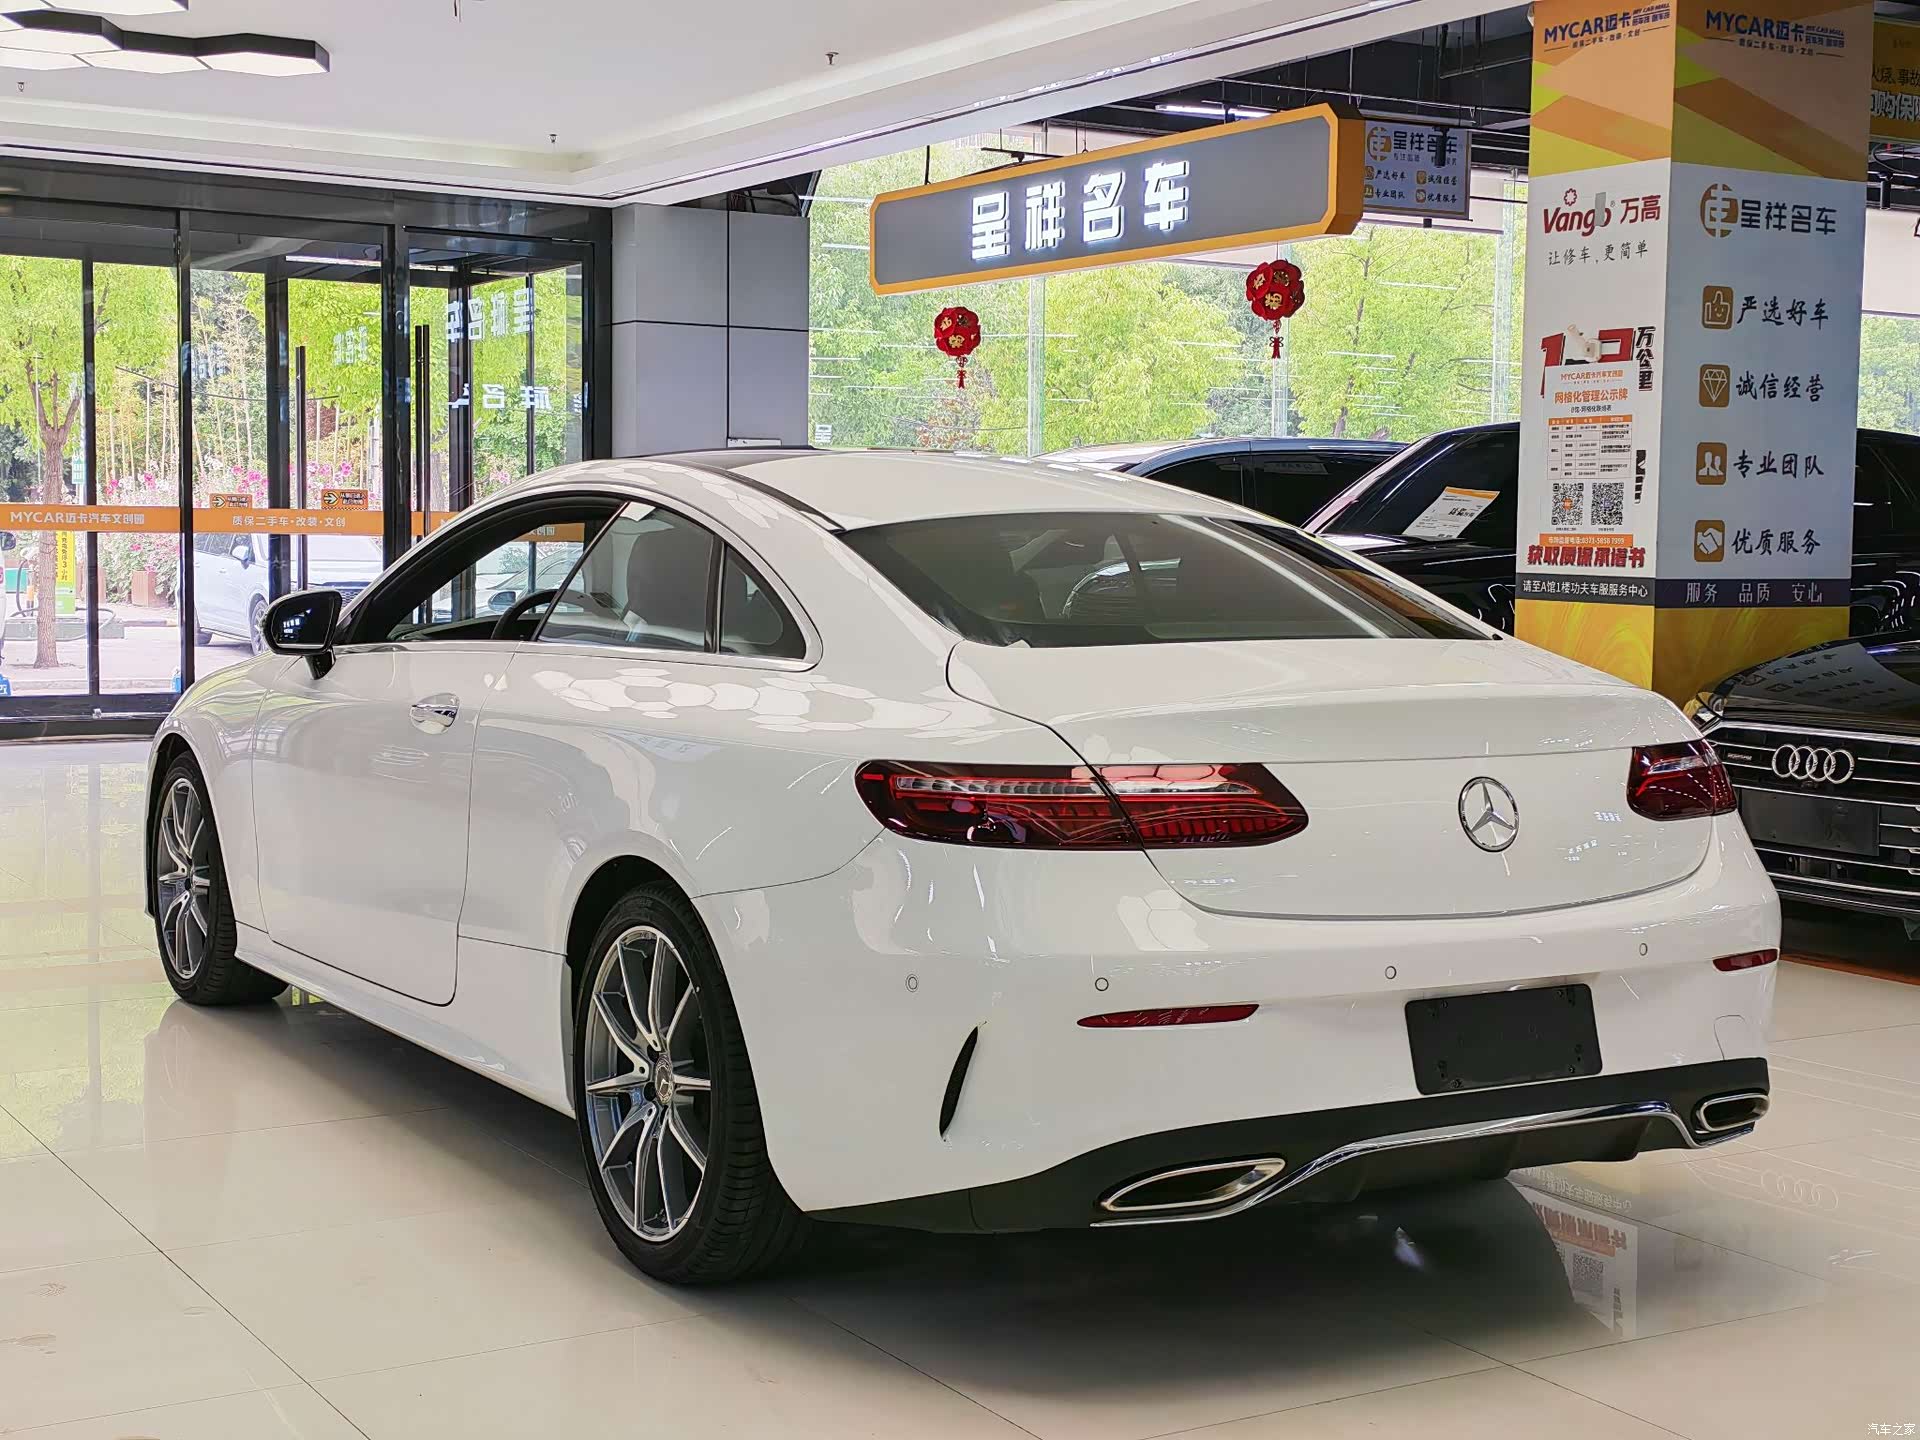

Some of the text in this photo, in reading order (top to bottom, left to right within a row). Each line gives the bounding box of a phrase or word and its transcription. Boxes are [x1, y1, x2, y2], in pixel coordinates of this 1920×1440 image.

[1543, 12, 1632, 44] MYCAR迈卡
[1705, 9, 1804, 42] MYCAR迈卡
[969, 159, 1191, 262] 呈祥名车
[1620, 195, 1661, 224] 万高
[1741, 199, 1837, 235] 呈祥名车
[1736, 295, 1829, 330] 严选好车
[1635, 326, 1656, 392] 万公里
[1554, 388, 1628, 404] 网格化管理公示牌
[1735, 370, 1825, 403] 诚信经营
[1733, 449, 1825, 479] 专业团队
[1527, 544, 1646, 569] 获取质保承诺书
[1730, 528, 1821, 556] 优质服务
[1684, 581, 1823, 604] 服务 品质 安心
